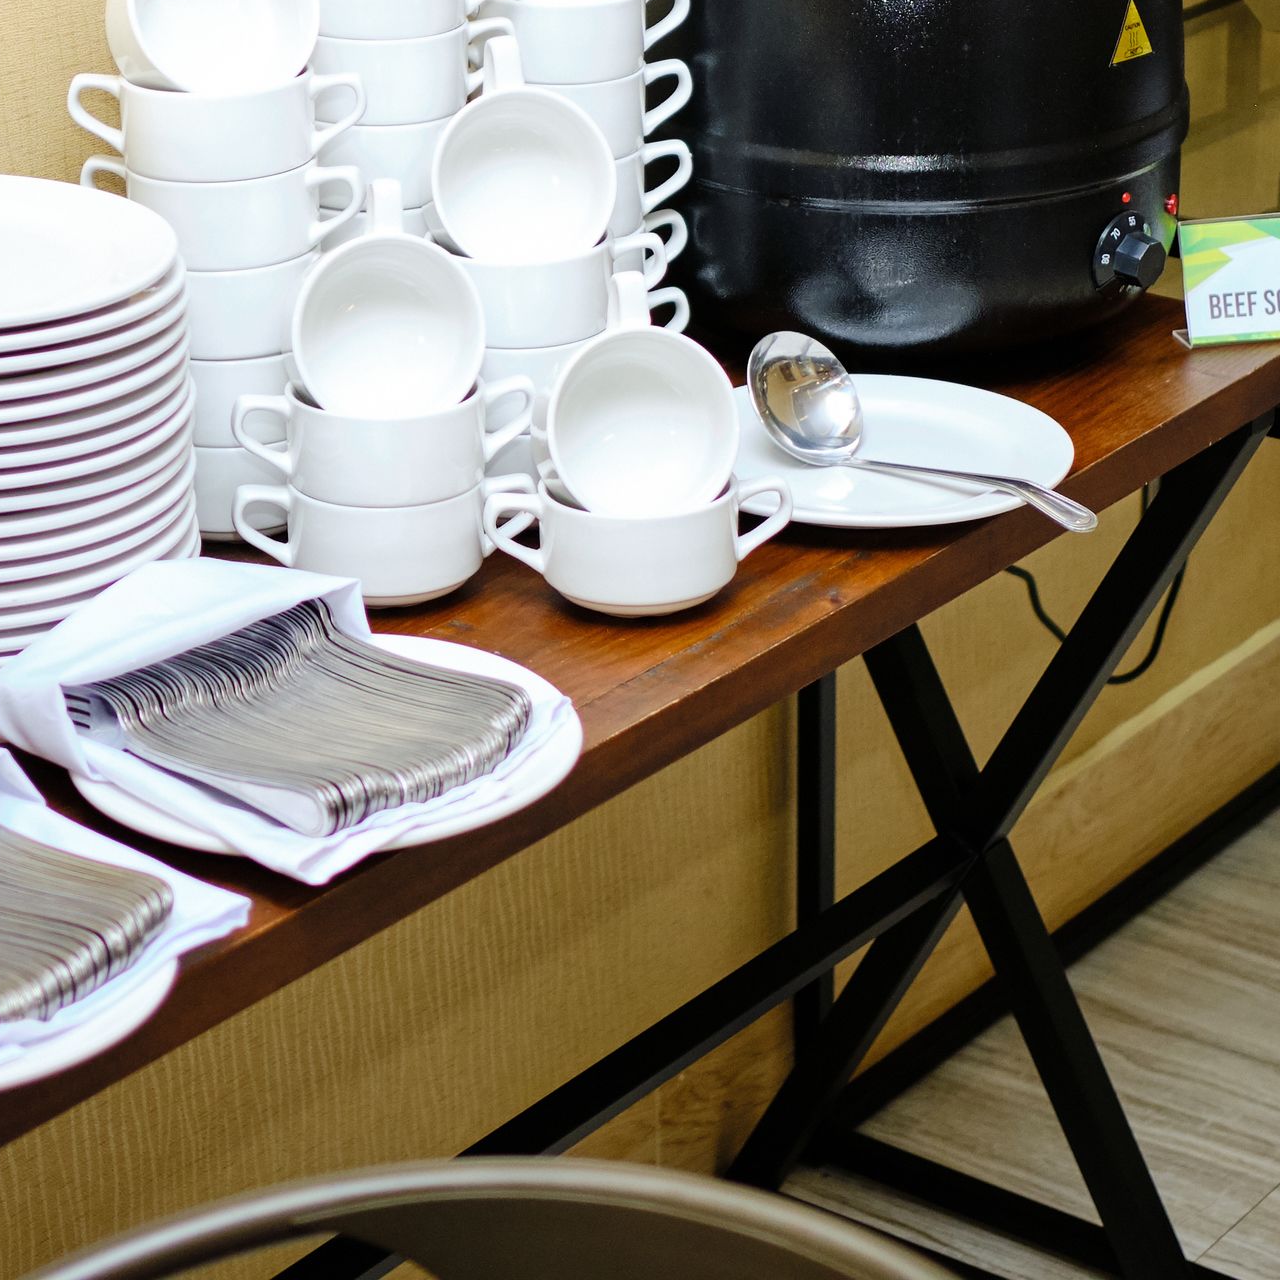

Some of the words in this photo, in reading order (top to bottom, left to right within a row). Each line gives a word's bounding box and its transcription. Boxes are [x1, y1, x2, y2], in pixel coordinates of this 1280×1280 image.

[1128, 215, 1136, 227] 55
[1110, 227, 1121, 240] 70
[1101, 253, 1111, 265] 80
[1208, 290, 1258, 320] BEEF
